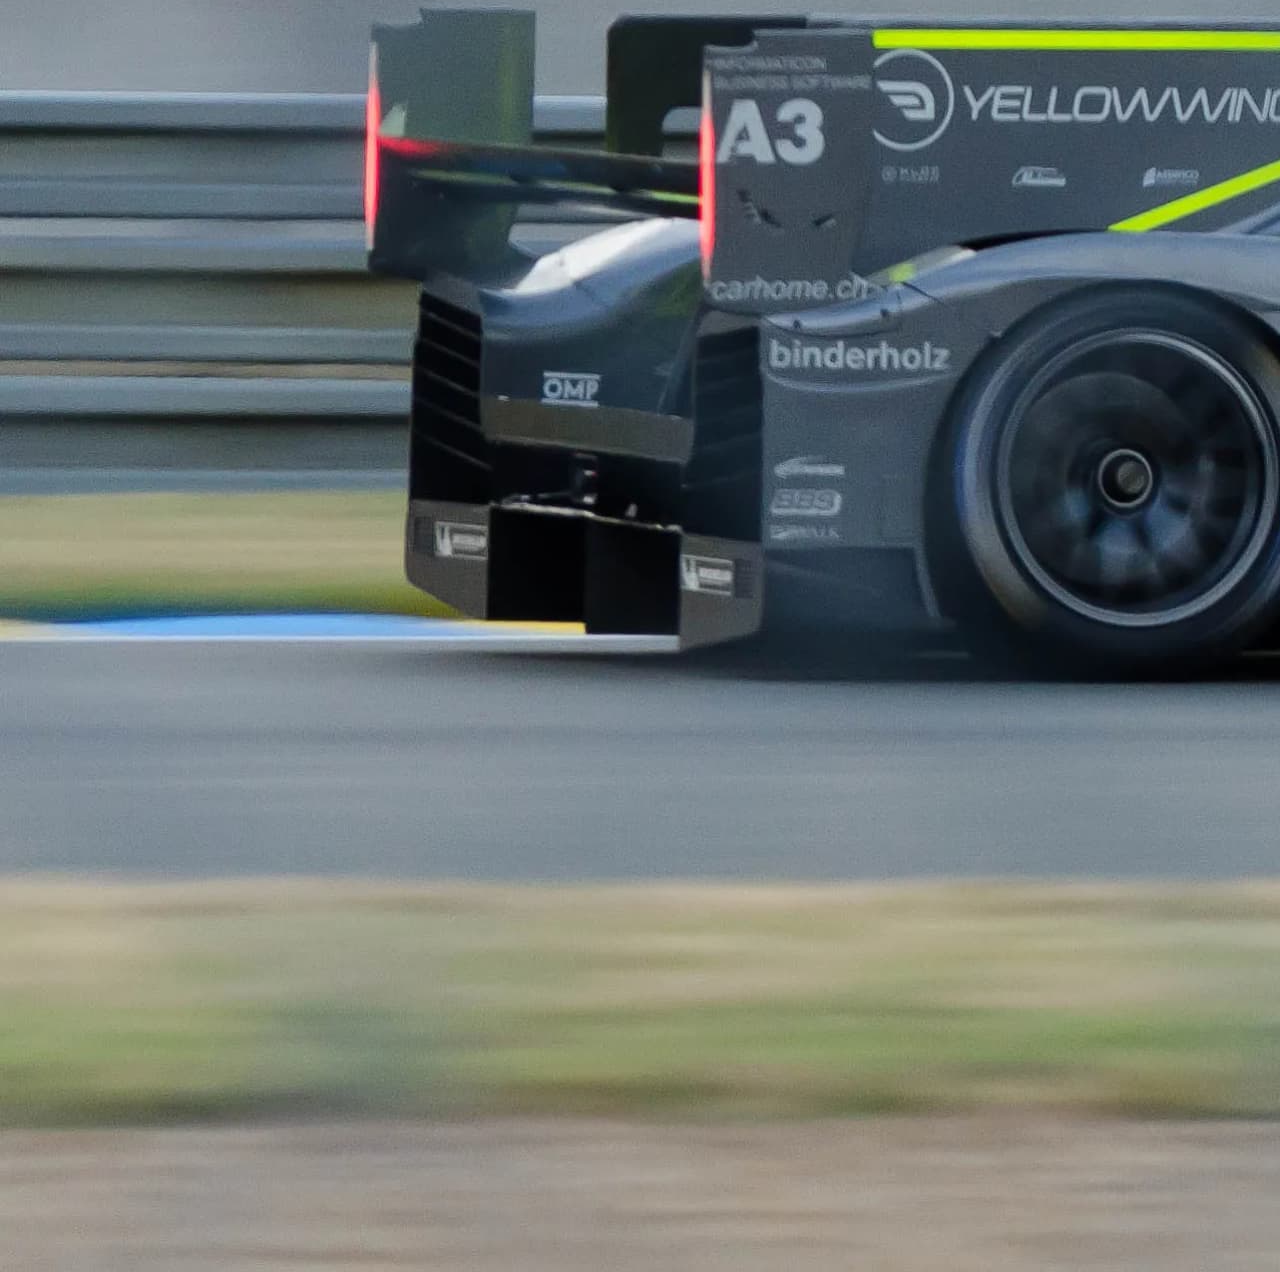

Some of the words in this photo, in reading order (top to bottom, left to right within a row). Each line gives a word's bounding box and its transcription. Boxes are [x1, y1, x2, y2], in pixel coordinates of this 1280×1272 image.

[716, 98, 825, 164] A3
[768, 339, 951, 370] binderholz
[543, 377, 598, 400] OMP
